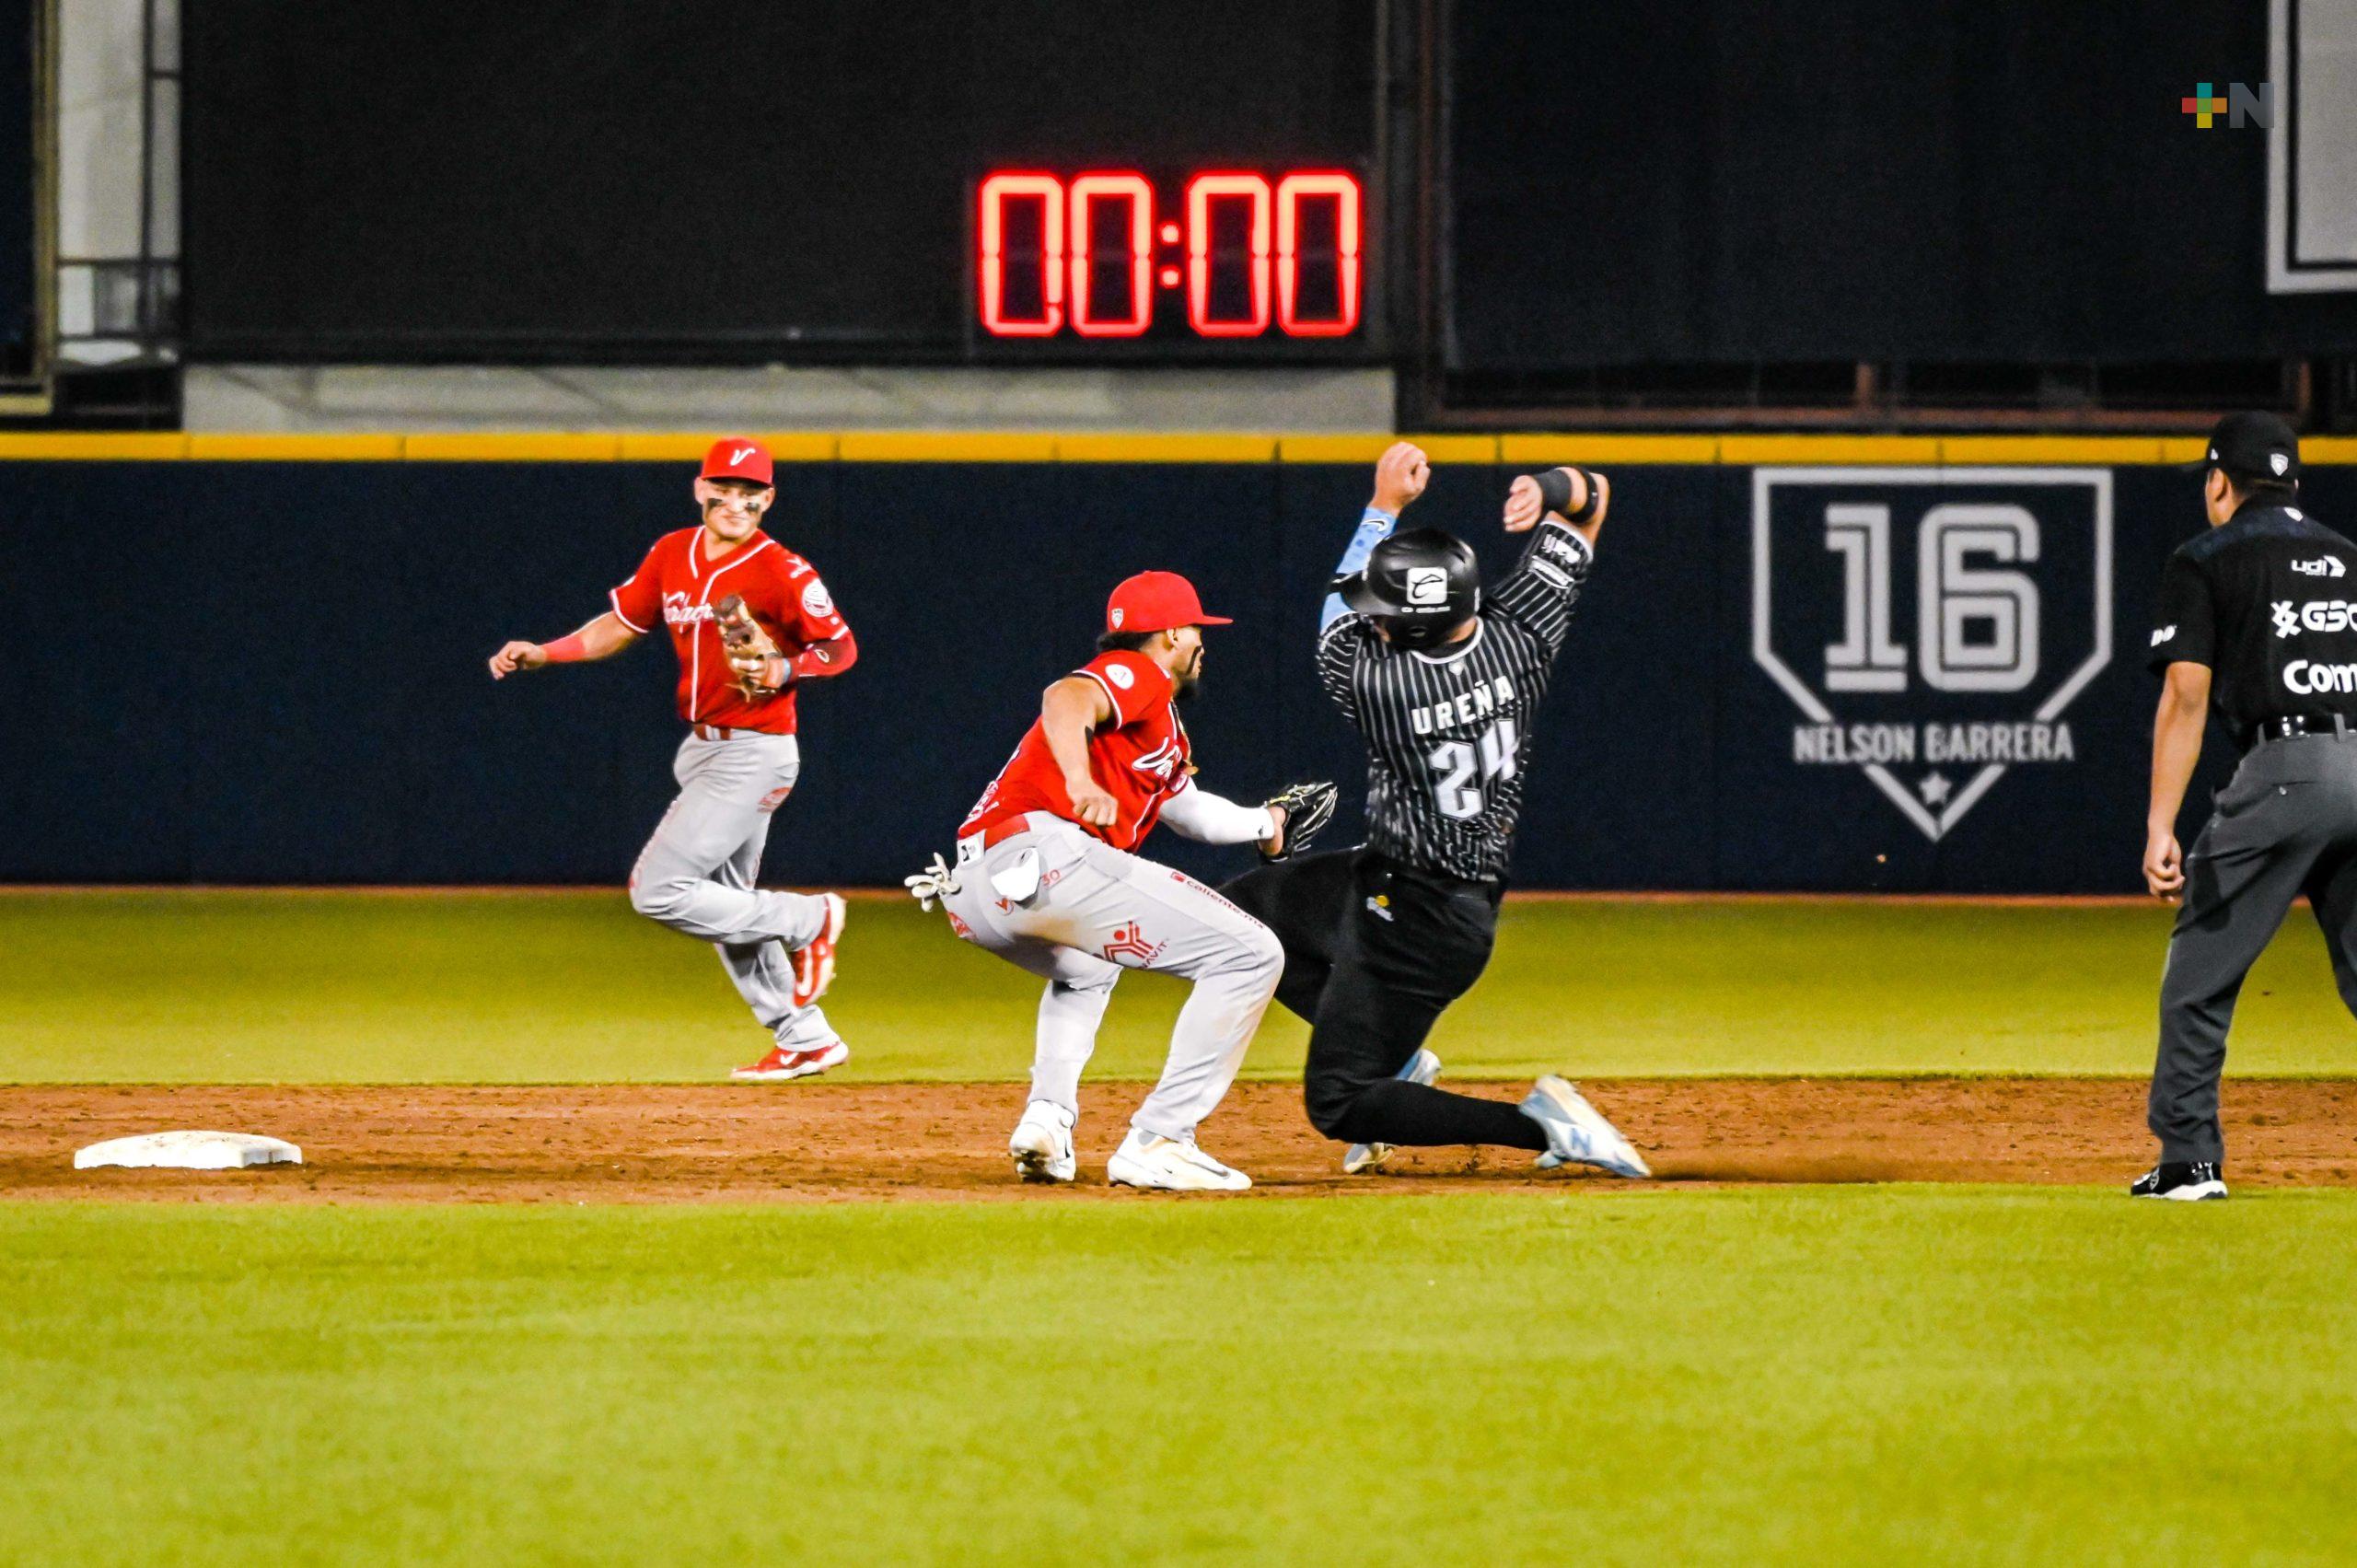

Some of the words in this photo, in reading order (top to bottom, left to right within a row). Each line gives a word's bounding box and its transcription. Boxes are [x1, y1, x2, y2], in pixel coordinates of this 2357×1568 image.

[981, 172, 1360, 337] 00:00
[1825, 505, 2039, 692] 16
[1411, 675, 1515, 735] UREÑA
[1794, 724, 1916, 764] NELSON
[1924, 723, 2073, 762] BARRERA
[1429, 718, 1521, 820] 24
